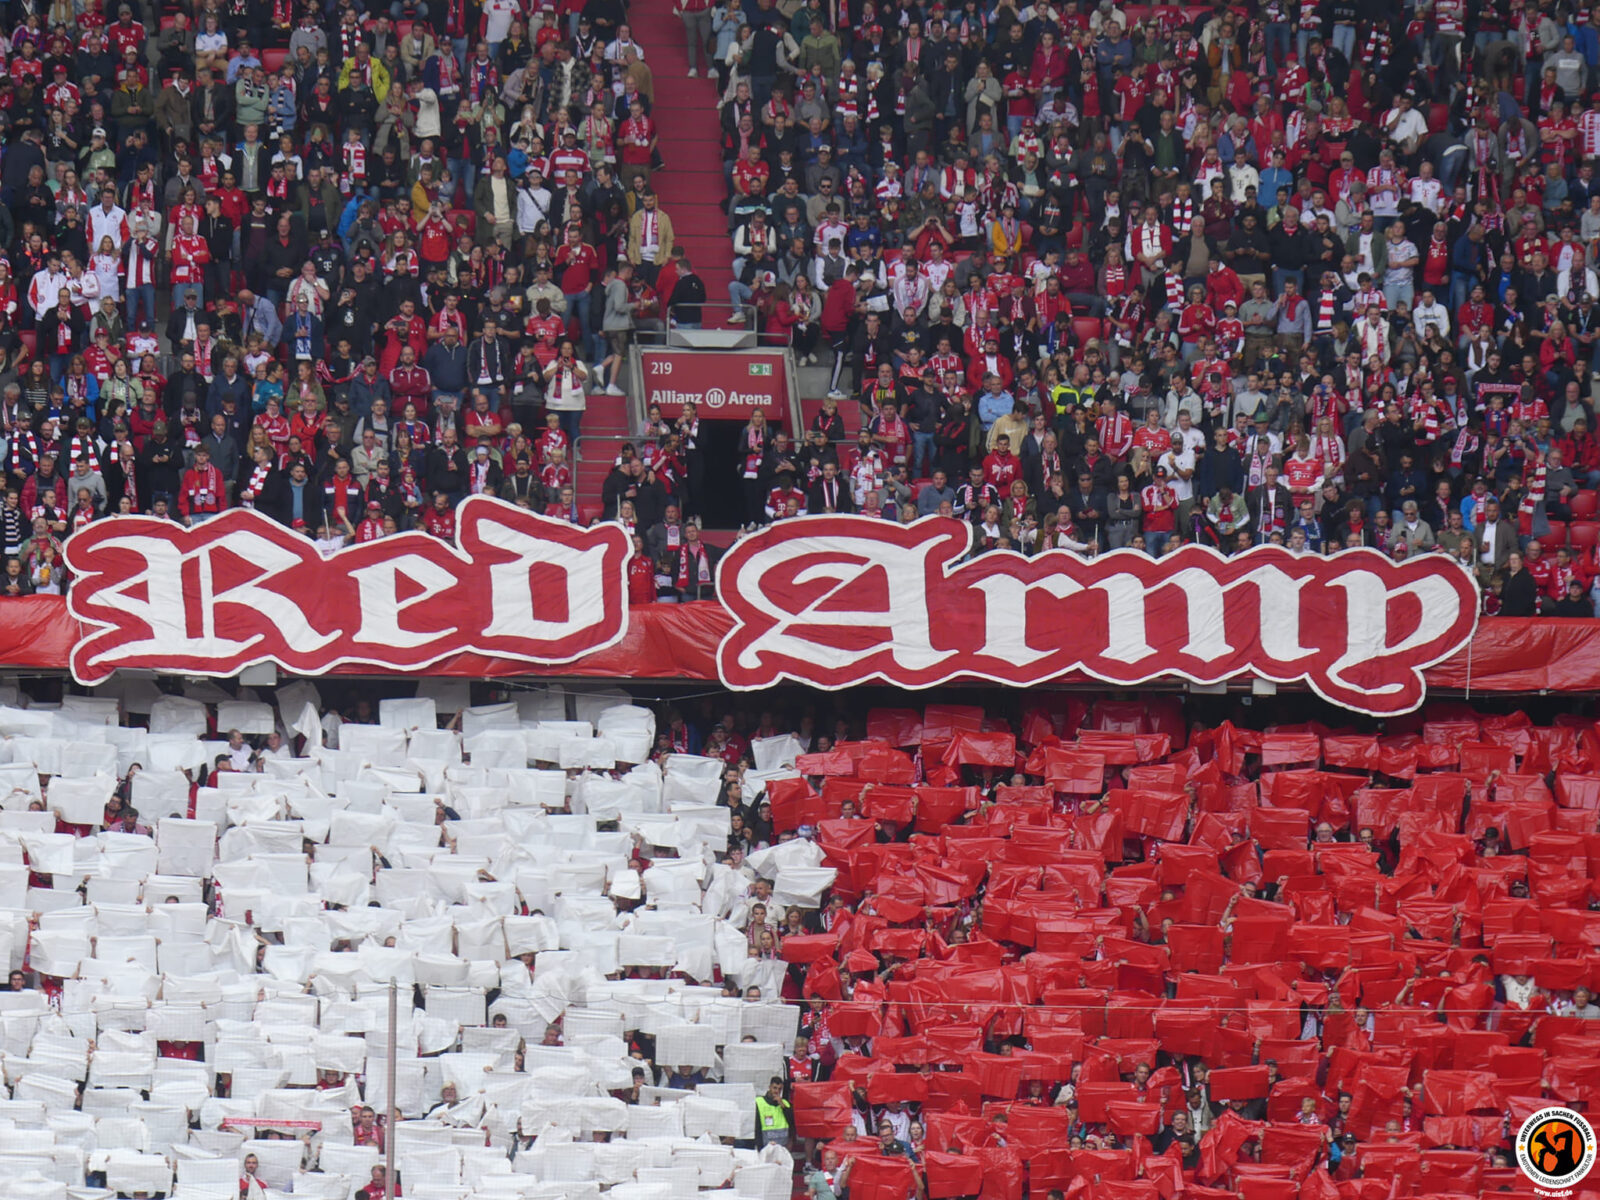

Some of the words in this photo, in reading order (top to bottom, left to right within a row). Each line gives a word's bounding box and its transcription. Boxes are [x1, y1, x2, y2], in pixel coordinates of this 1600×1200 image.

[651, 361, 672, 375] 219
[650, 389, 703, 404] Allianz
[728, 391, 772, 405] Arena
[87, 518, 608, 658] Red
[737, 533, 1461, 695] Army
